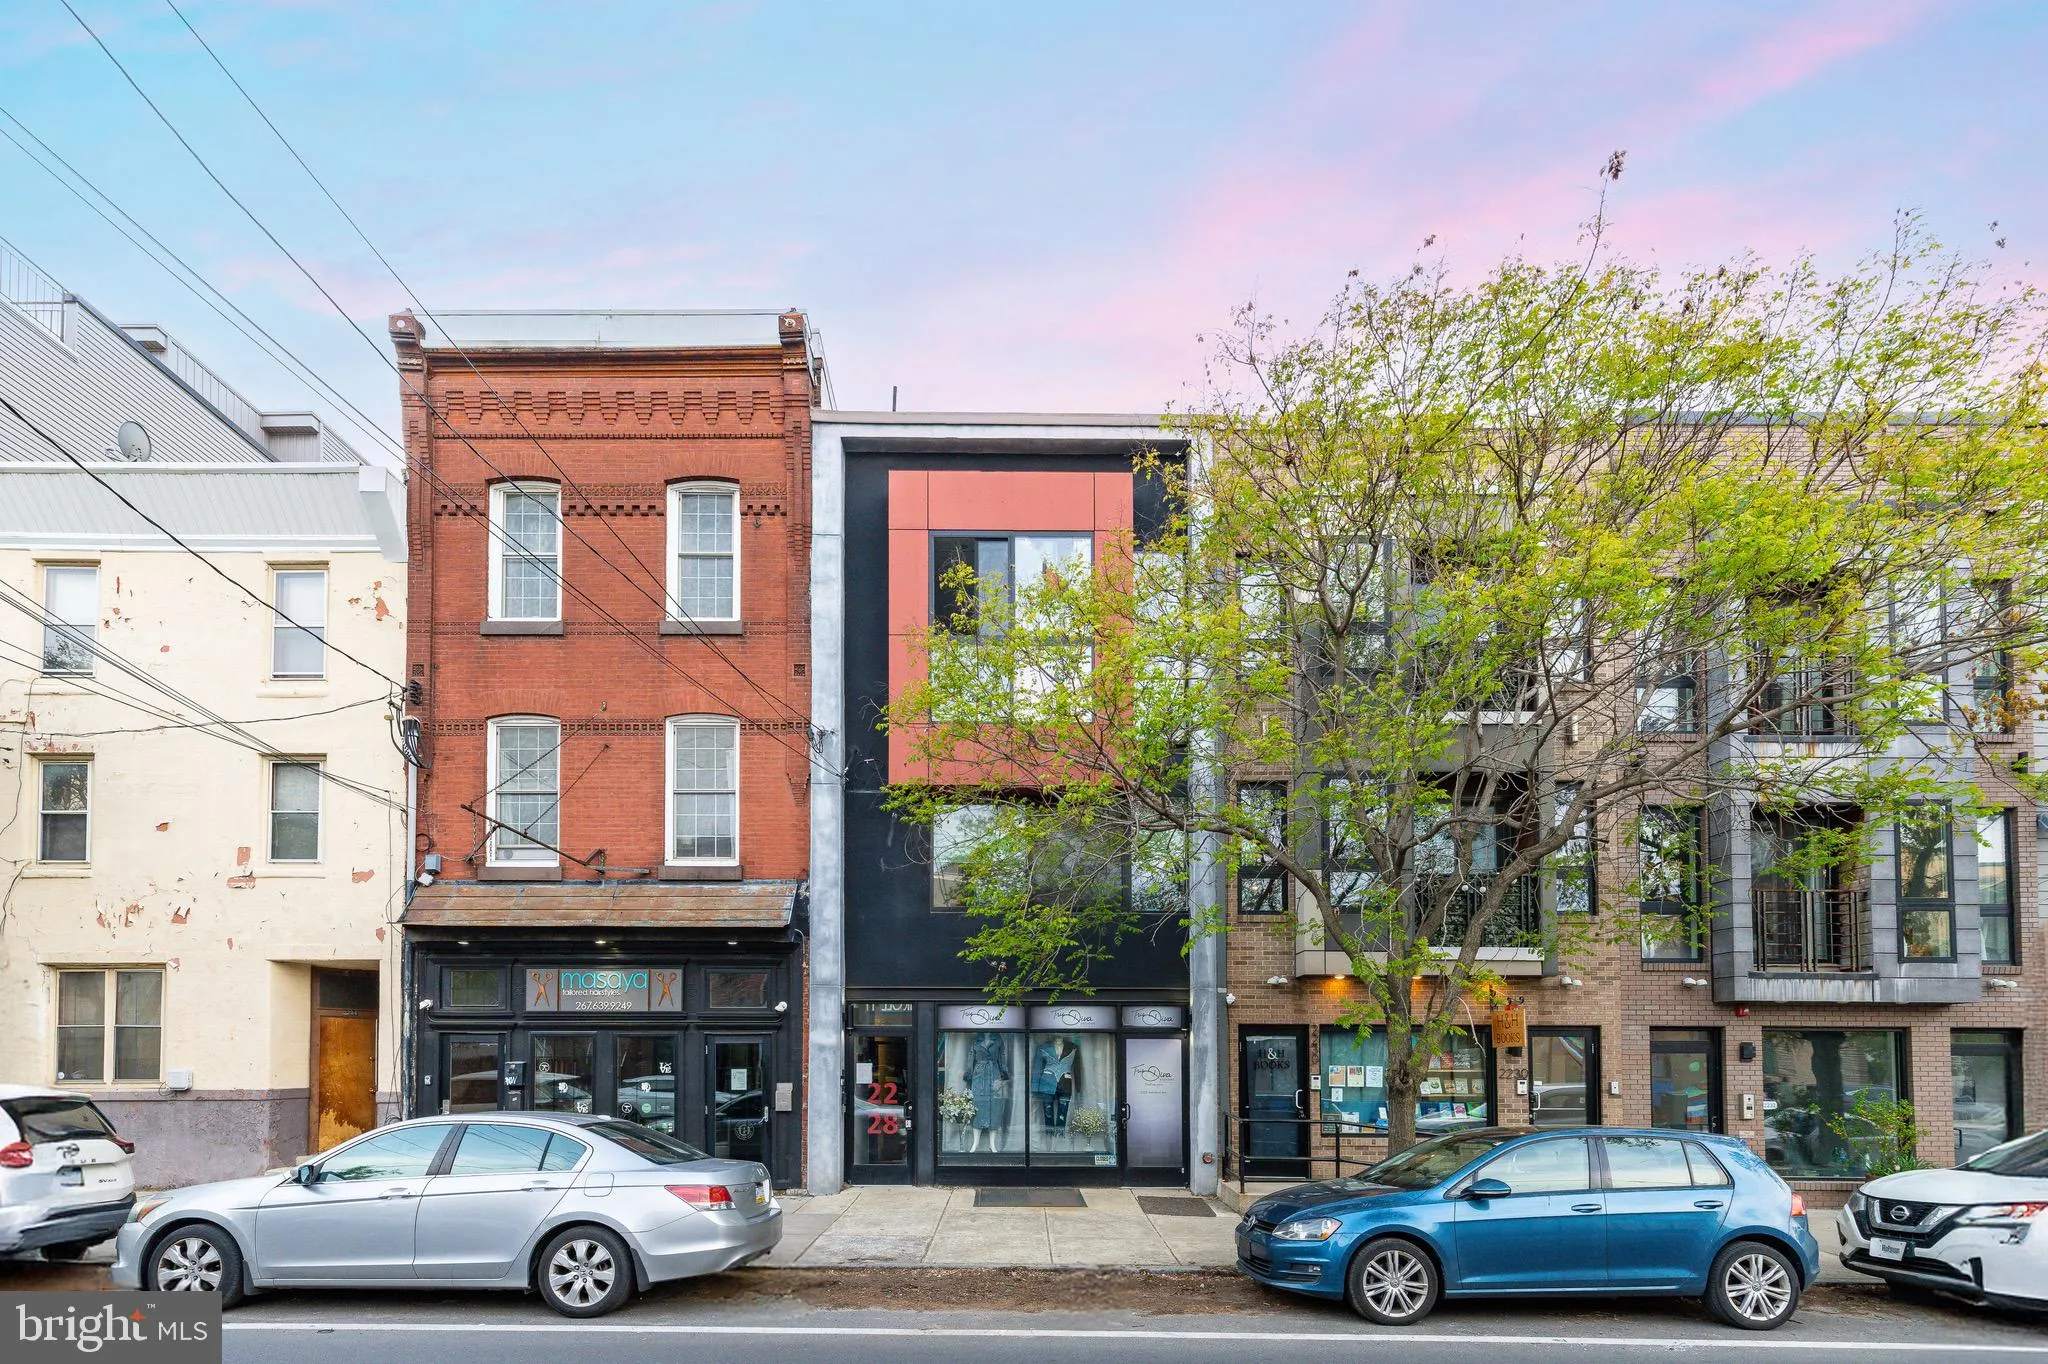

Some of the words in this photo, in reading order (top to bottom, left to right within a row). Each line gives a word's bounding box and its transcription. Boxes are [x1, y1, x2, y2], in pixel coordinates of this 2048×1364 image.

[561, 971, 648, 992] masaya
[575, 1001, 633, 1010] 267.639.9249
[1496, 1012, 1519, 1029] H&H
[1496, 1032, 1520, 1044] BOOKS
[1498, 1068, 1528, 1079] 2230
[867, 1083, 898, 1104] 22
[867, 1112, 898, 1135] 28
